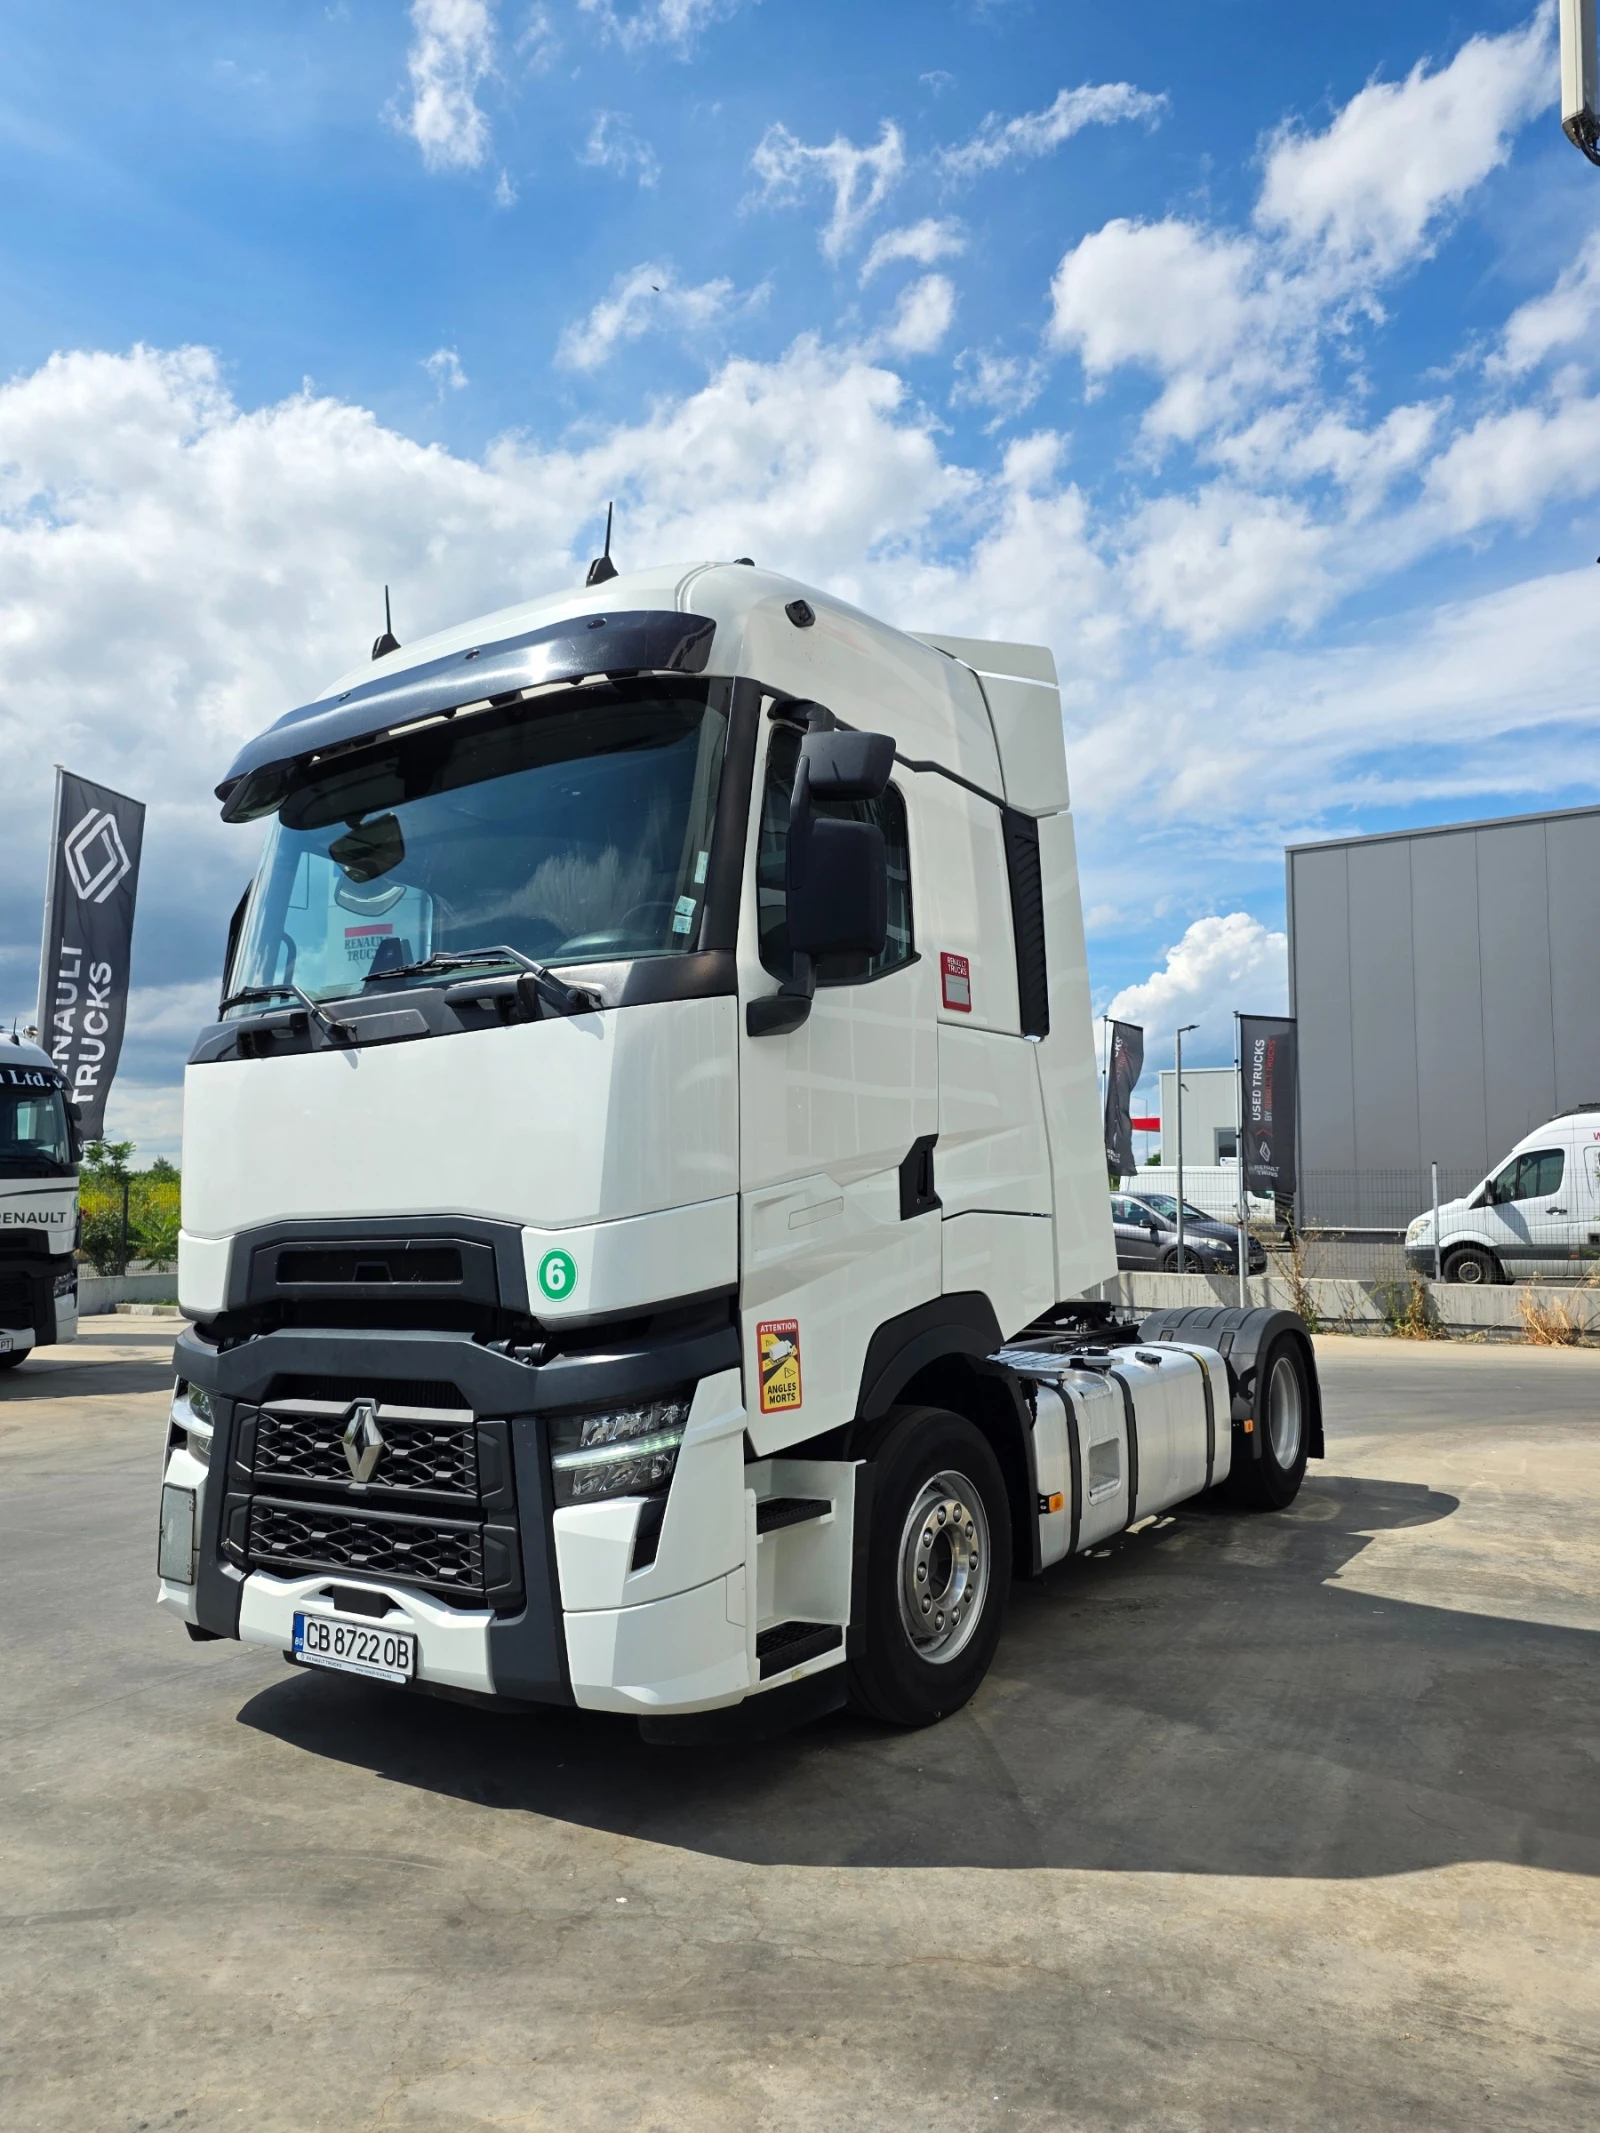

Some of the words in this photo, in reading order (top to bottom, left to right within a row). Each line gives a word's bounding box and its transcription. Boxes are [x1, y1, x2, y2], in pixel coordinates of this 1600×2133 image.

[345, 936, 387, 950] RENAU
[347, 949, 376, 961] TRUC
[947, 956, 966, 967] RENAULT
[948, 964, 967, 976] TRUCKS
[71, 962, 112, 1104] TRUCKS
[1266, 1039, 1276, 1071] TRUCKS
[1252, 1039, 1265, 1087] TRUCKS
[8, 1069, 51, 1088] Ltd.
[1252, 1090, 1262, 1121] USED
[1264, 1110, 1272, 1122] BY
[0, 1212, 67, 1224] ENAULT
[545, 1258, 566, 1291] 6
[760, 1321, 797, 1333] ATTENTION
[767, 1382, 797, 1395] ANGLES
[769, 1393, 796, 1405] MORTS
[294, 1637, 304, 1646] BG
[306, 1622, 331, 1652] CB
[334, 1628, 380, 1664] 8722
